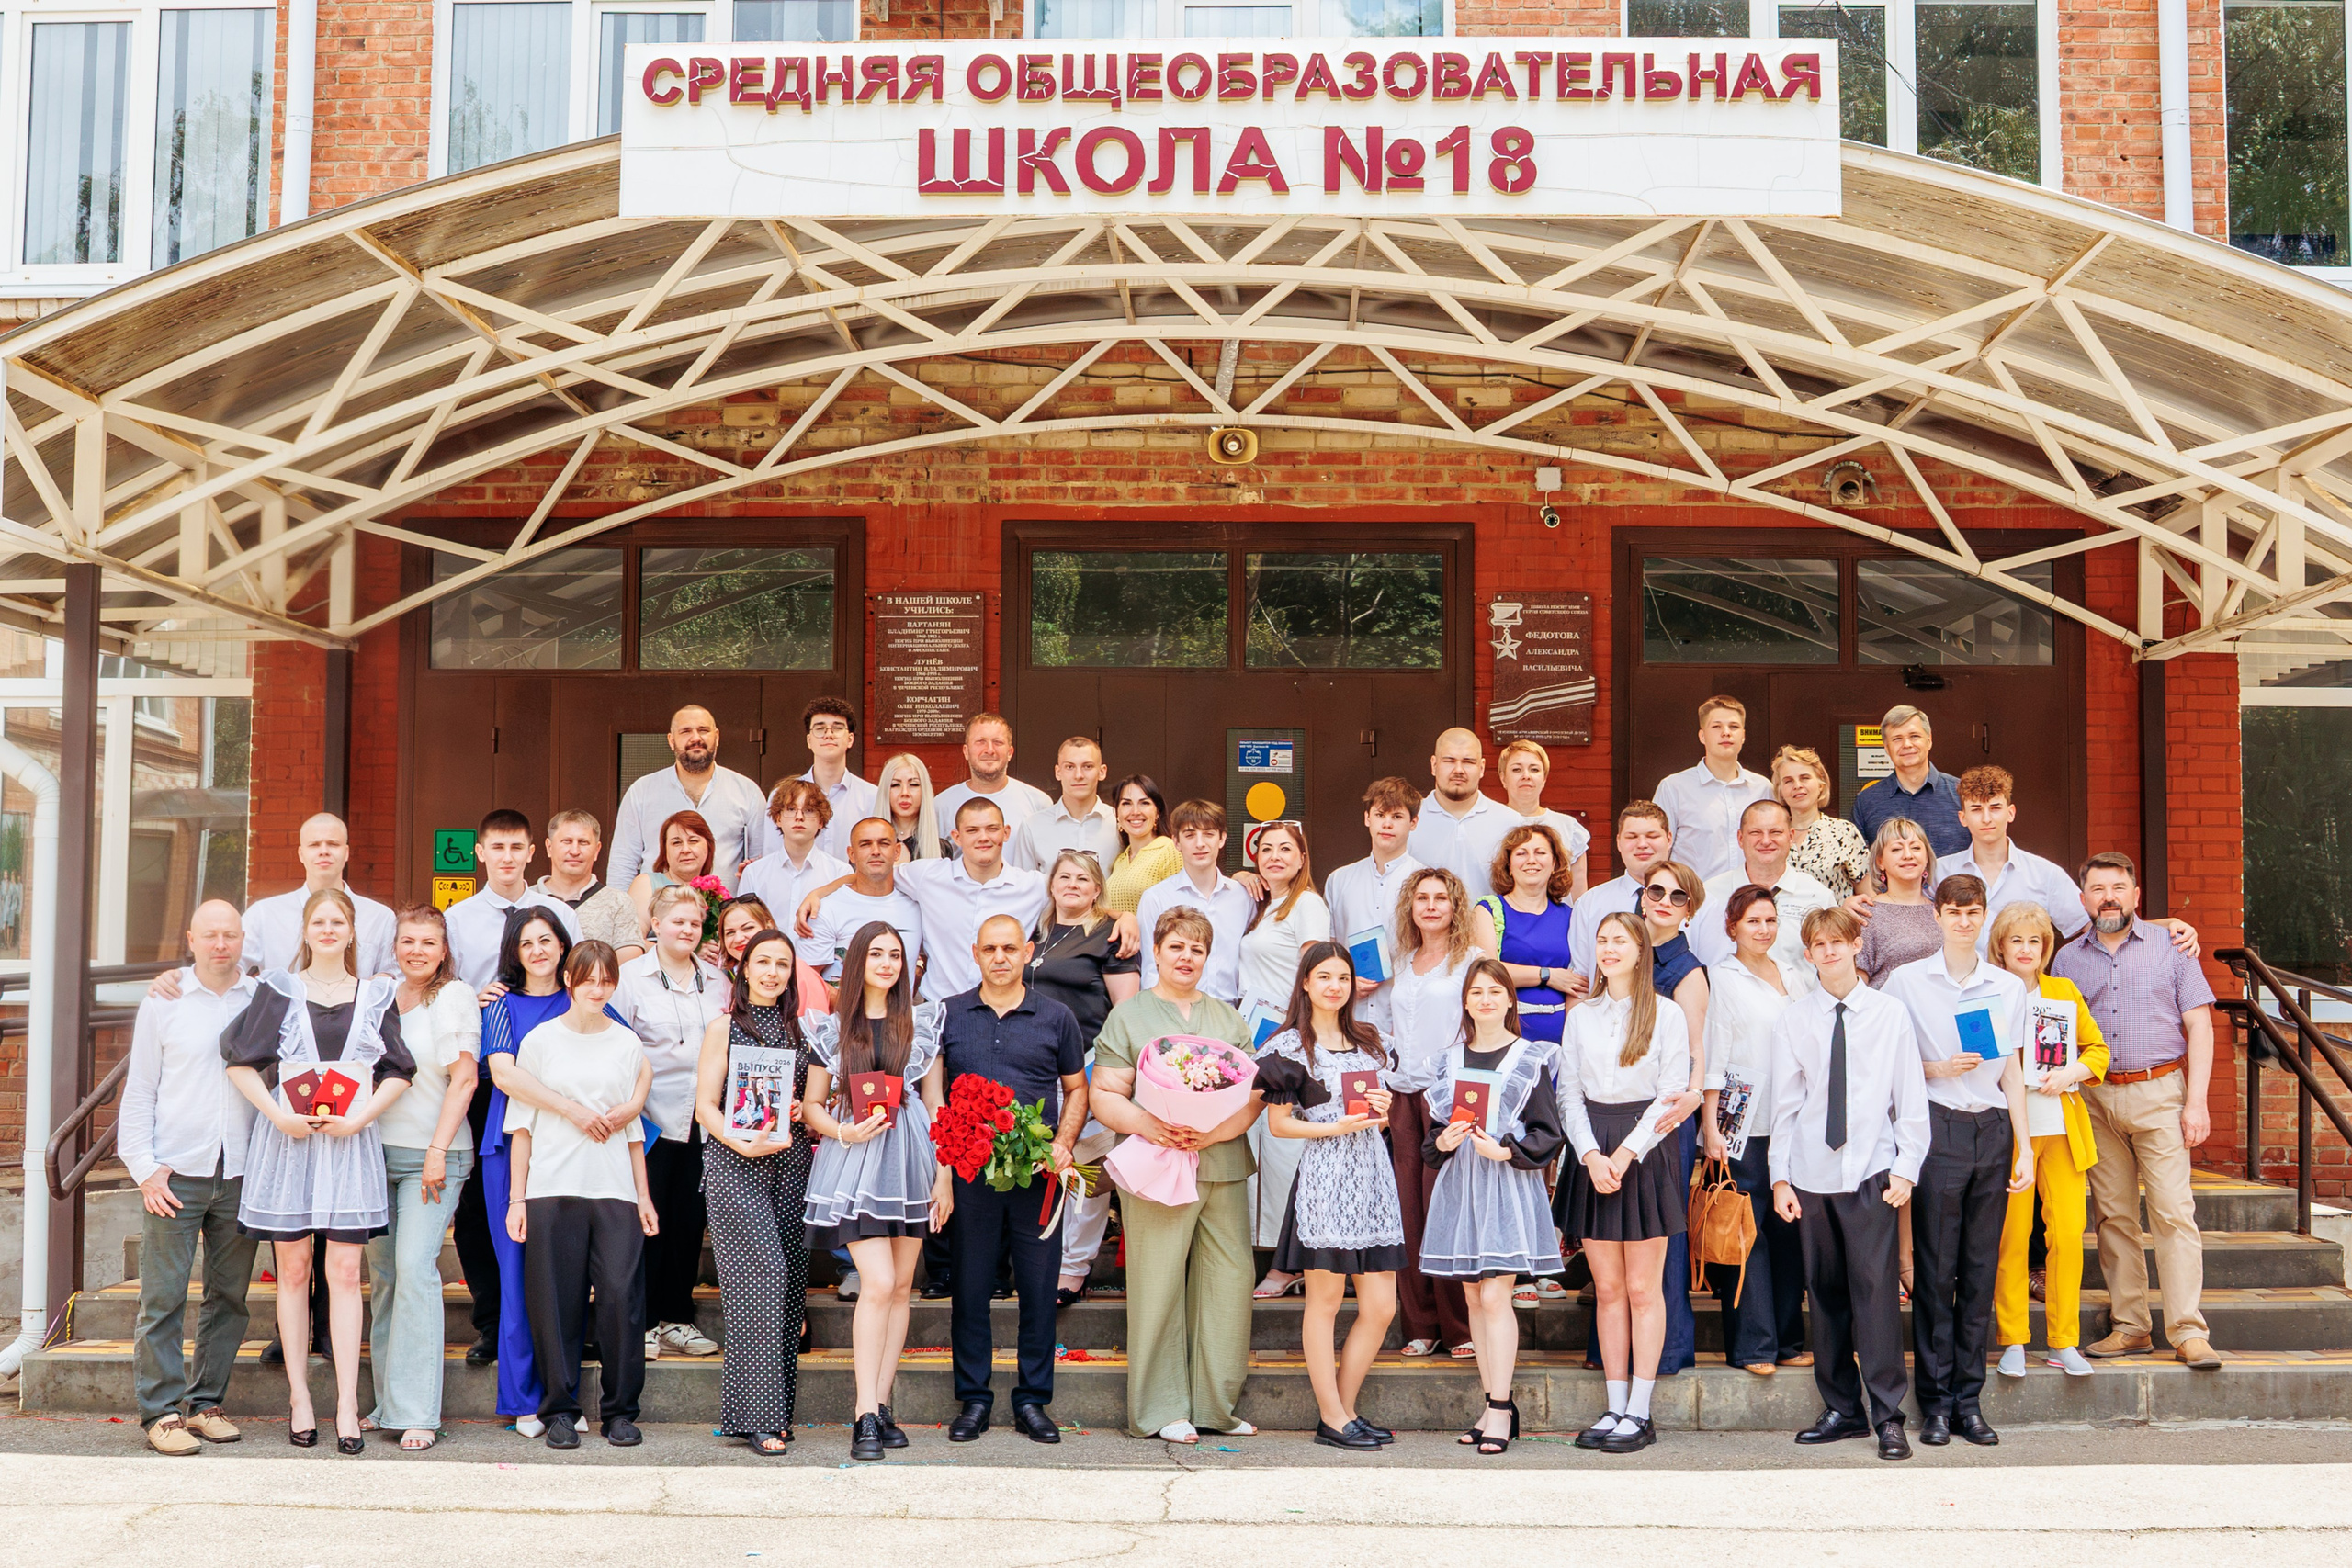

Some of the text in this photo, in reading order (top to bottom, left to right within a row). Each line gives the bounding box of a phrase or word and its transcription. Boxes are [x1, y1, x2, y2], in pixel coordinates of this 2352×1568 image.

[642, 51, 1822, 115] СРЕДНЯЯ ОБЩЕОБРАЗОВАТЕЛЬНАЯ
[918, 126, 1538, 197] ШКОЛА №18
[895, 595, 933, 604] НАШЕЙ
[935, 596, 973, 604] ШКОЛЕ
[904, 606, 955, 615] УЧИЛИСЬ:
[1525, 631, 1580, 640] ФЕДОТОВА
[737, 1061, 783, 1075] ВЫПУСК
